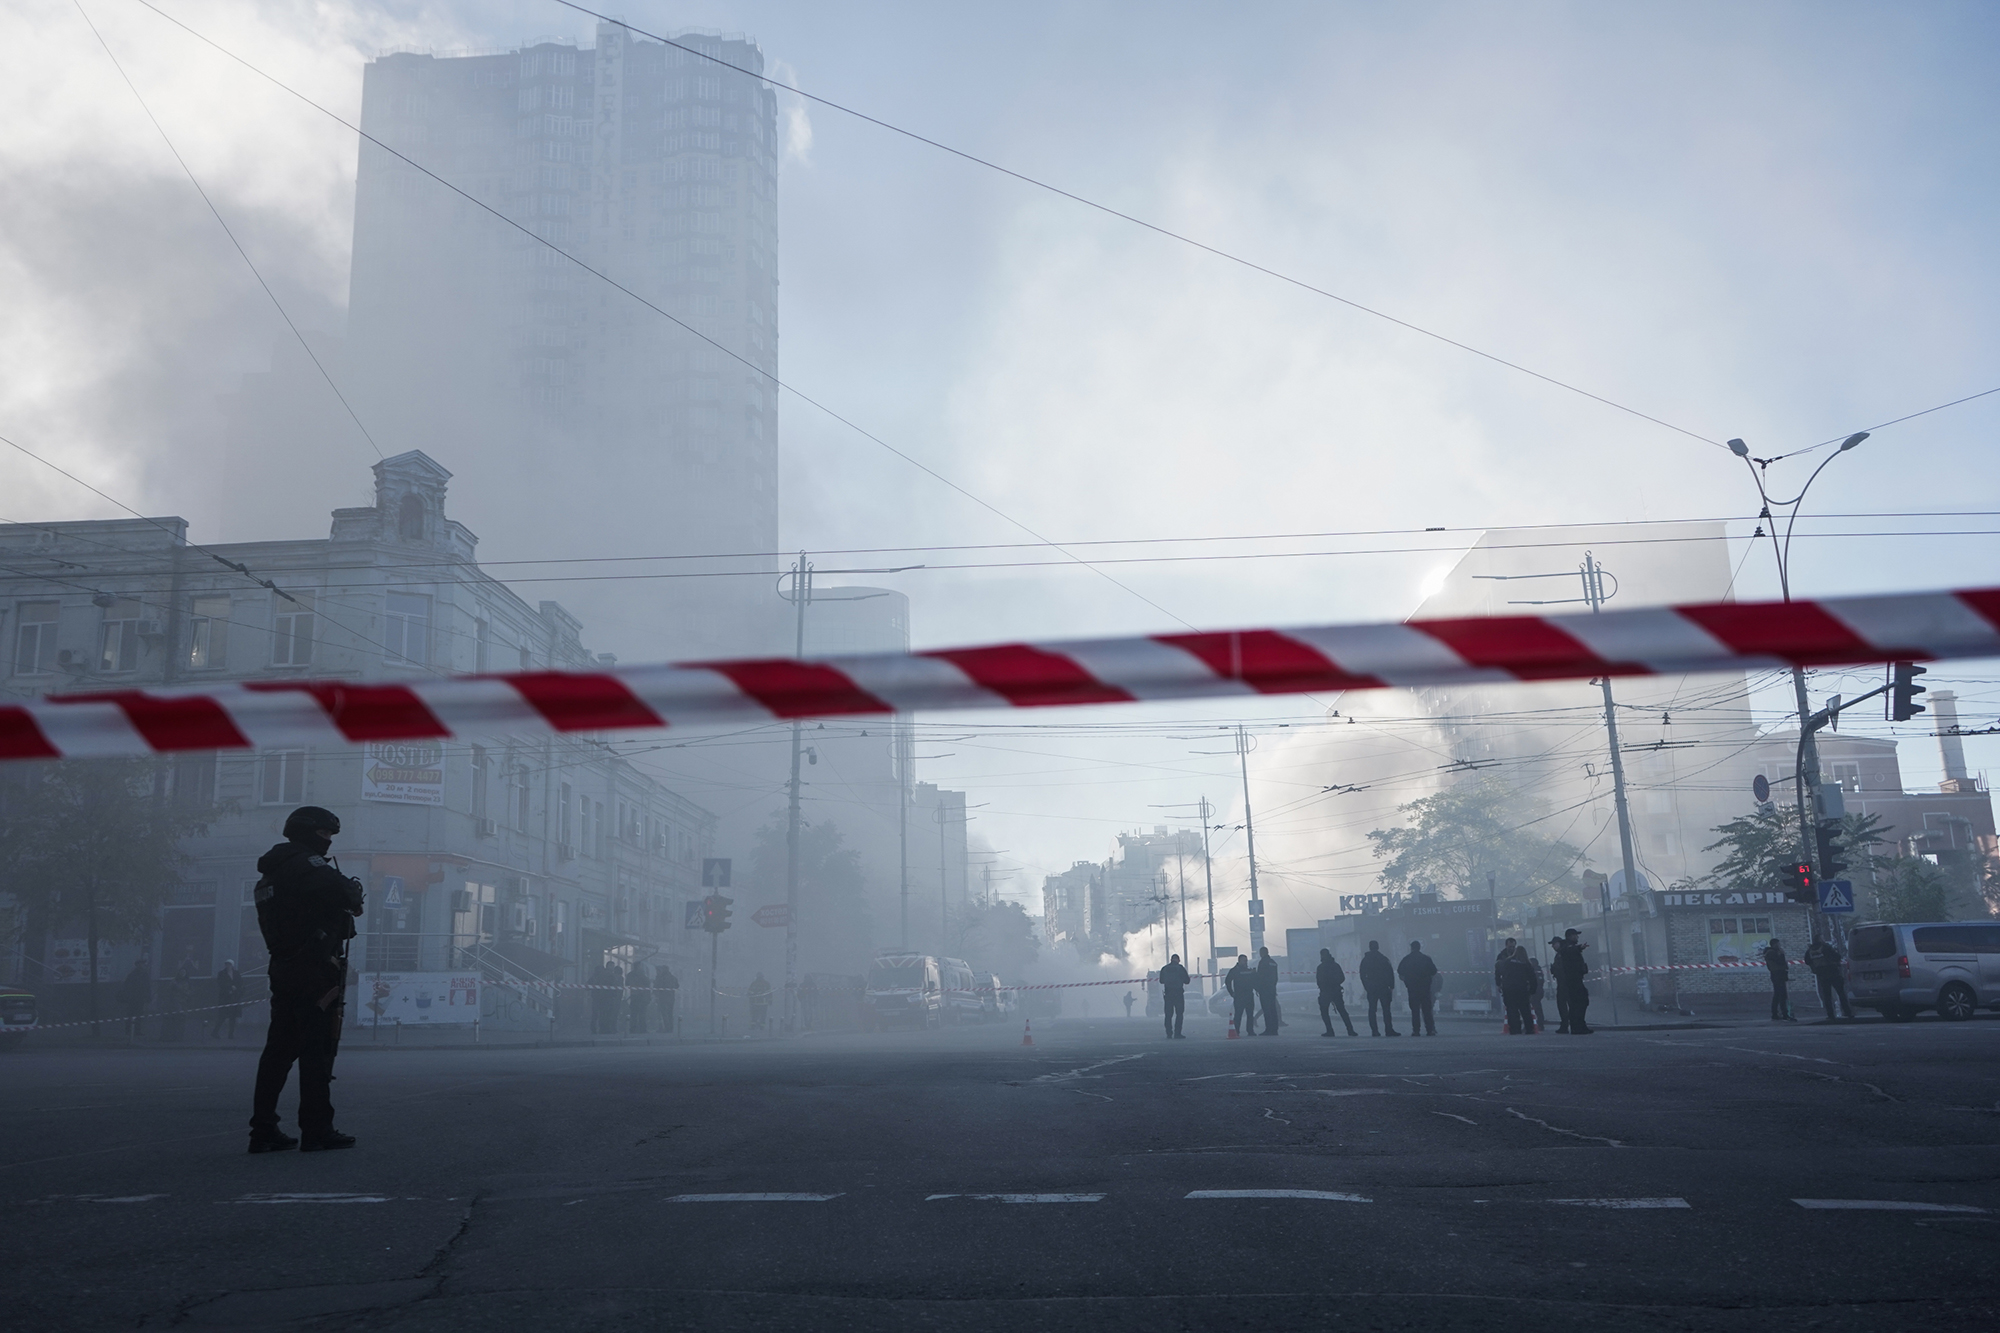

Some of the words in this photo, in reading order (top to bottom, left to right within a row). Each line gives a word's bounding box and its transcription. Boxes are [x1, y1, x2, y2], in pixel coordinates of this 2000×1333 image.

[371, 743, 440, 766] HOSTEL
[375, 769, 394, 780] 098
[396, 770, 414, 781] 777
[416, 770, 440, 781] 4477
[385, 784, 396, 792] 20
[414, 788, 440, 796] поверх
[433, 795, 441, 803] 23
[1339, 892, 1401, 911] КВІТИ
[1663, 892, 1796, 906] ПЕКАРН
[1413, 907, 1441, 915] FISHKI
[1452, 904, 1481, 914] COFFEE
